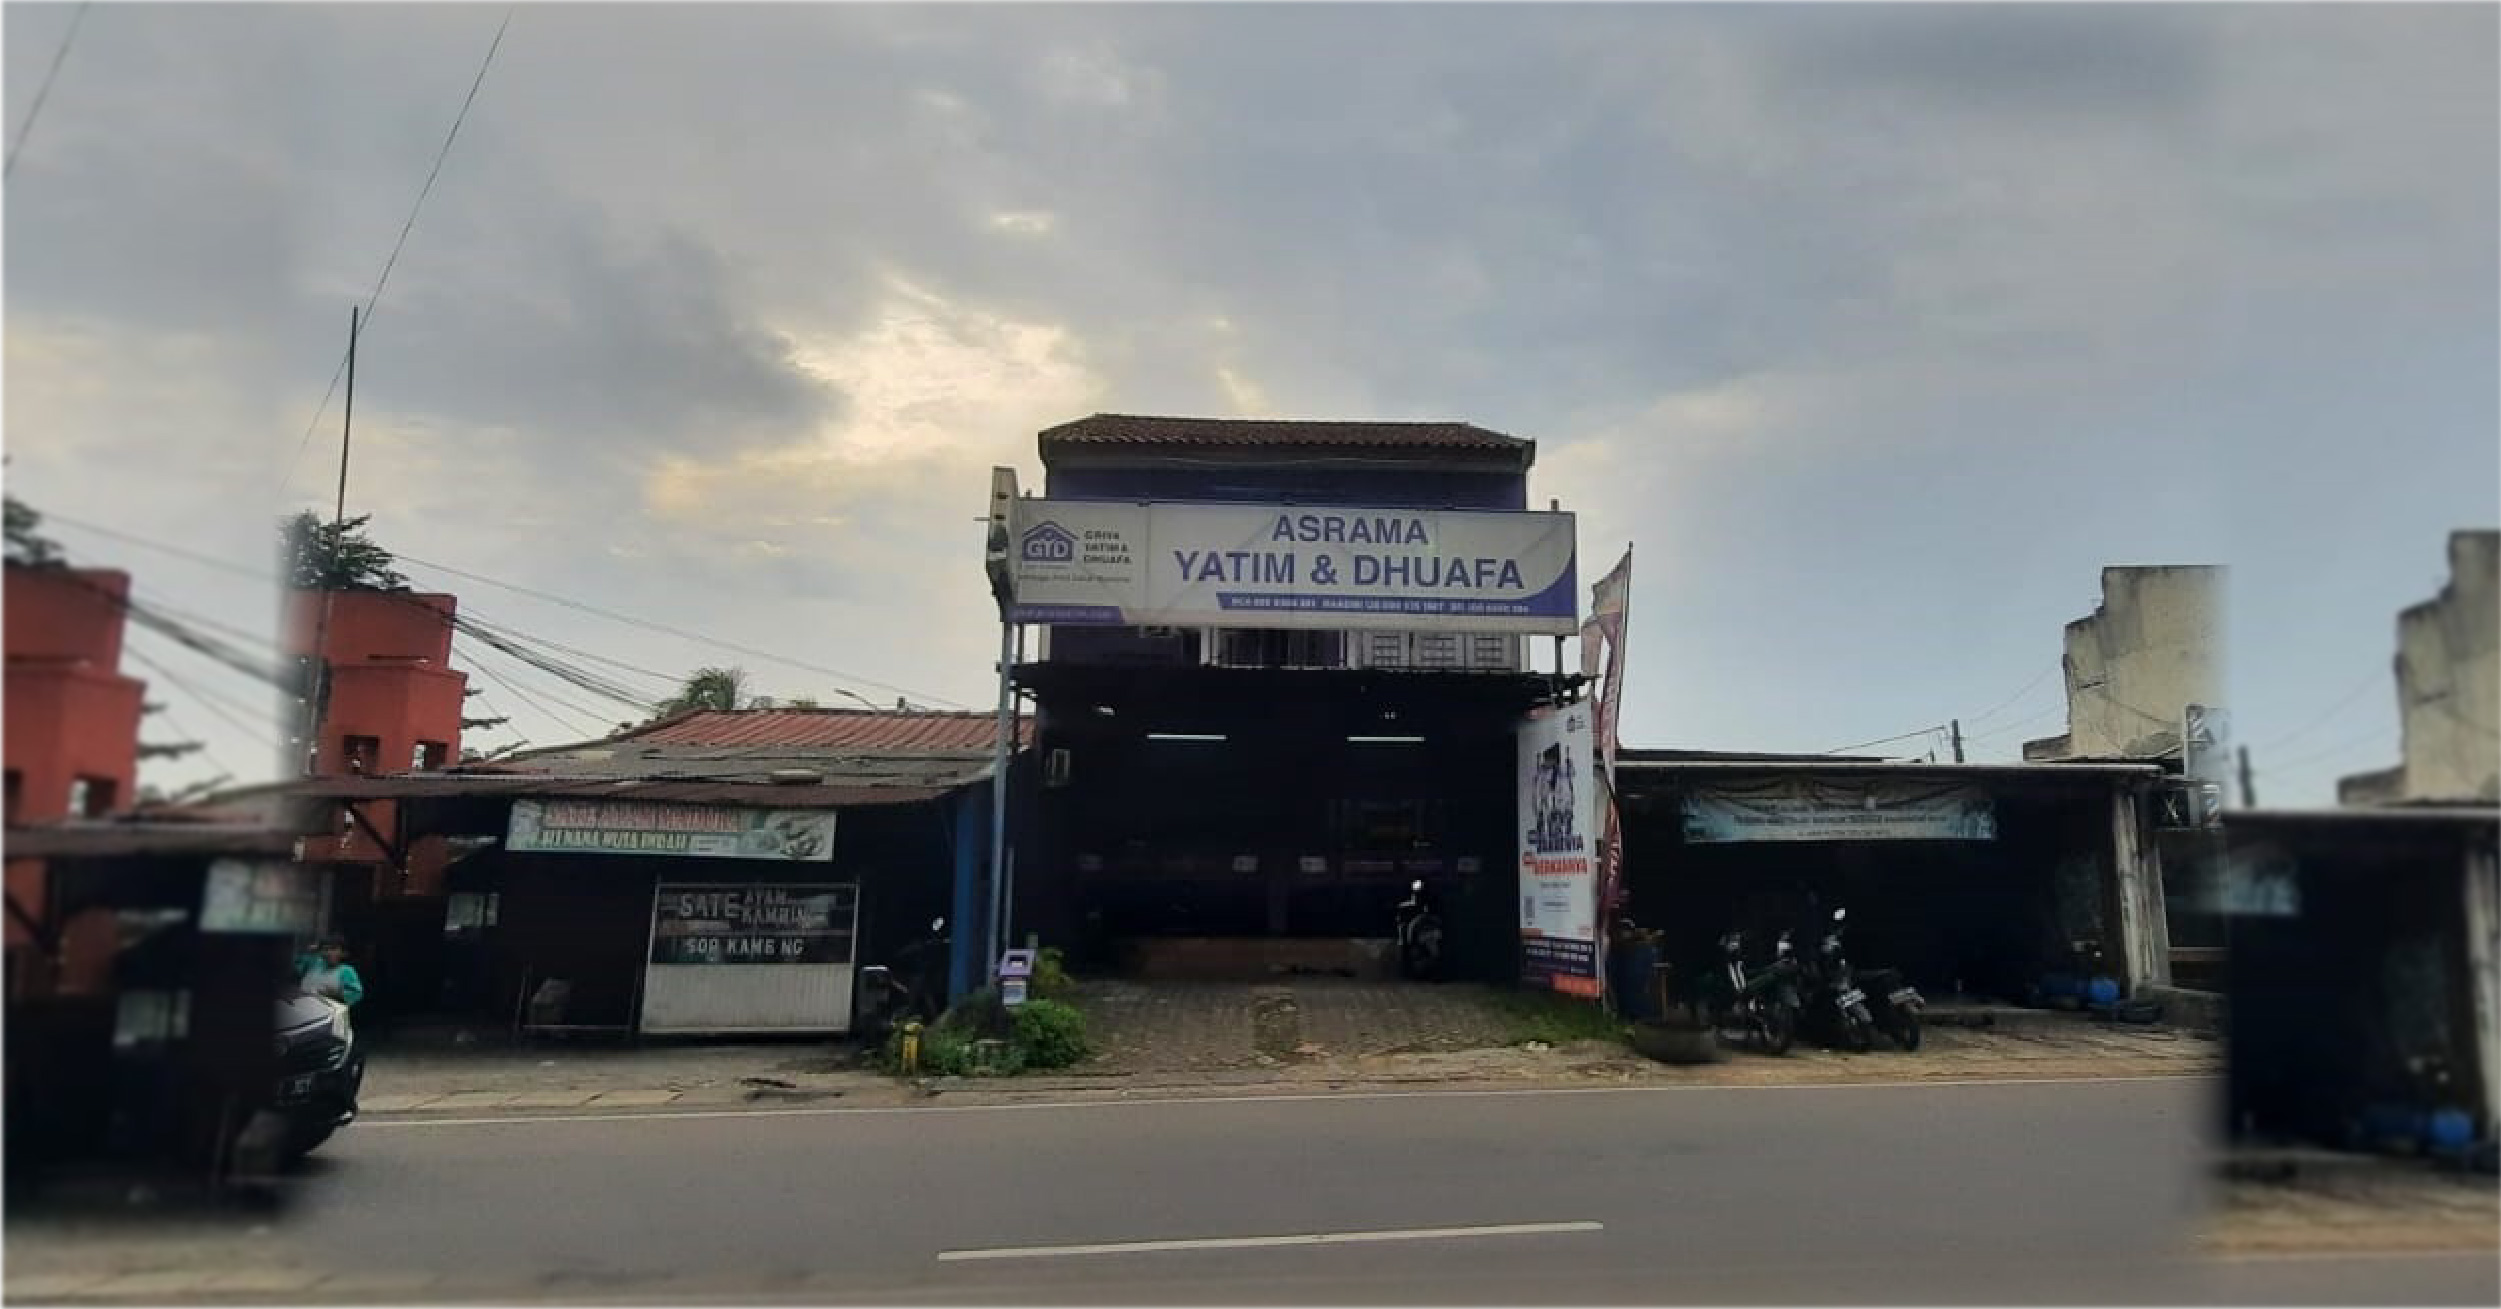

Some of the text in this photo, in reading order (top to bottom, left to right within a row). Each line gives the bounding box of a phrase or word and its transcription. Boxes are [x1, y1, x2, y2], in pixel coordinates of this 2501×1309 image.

[1272, 515, 1428, 544] ASRAMA
[1027, 540, 1069, 558] GYD
[1173, 551, 1525, 589] YATIM & DHUAFA
[680, 893, 741, 918] SATE
